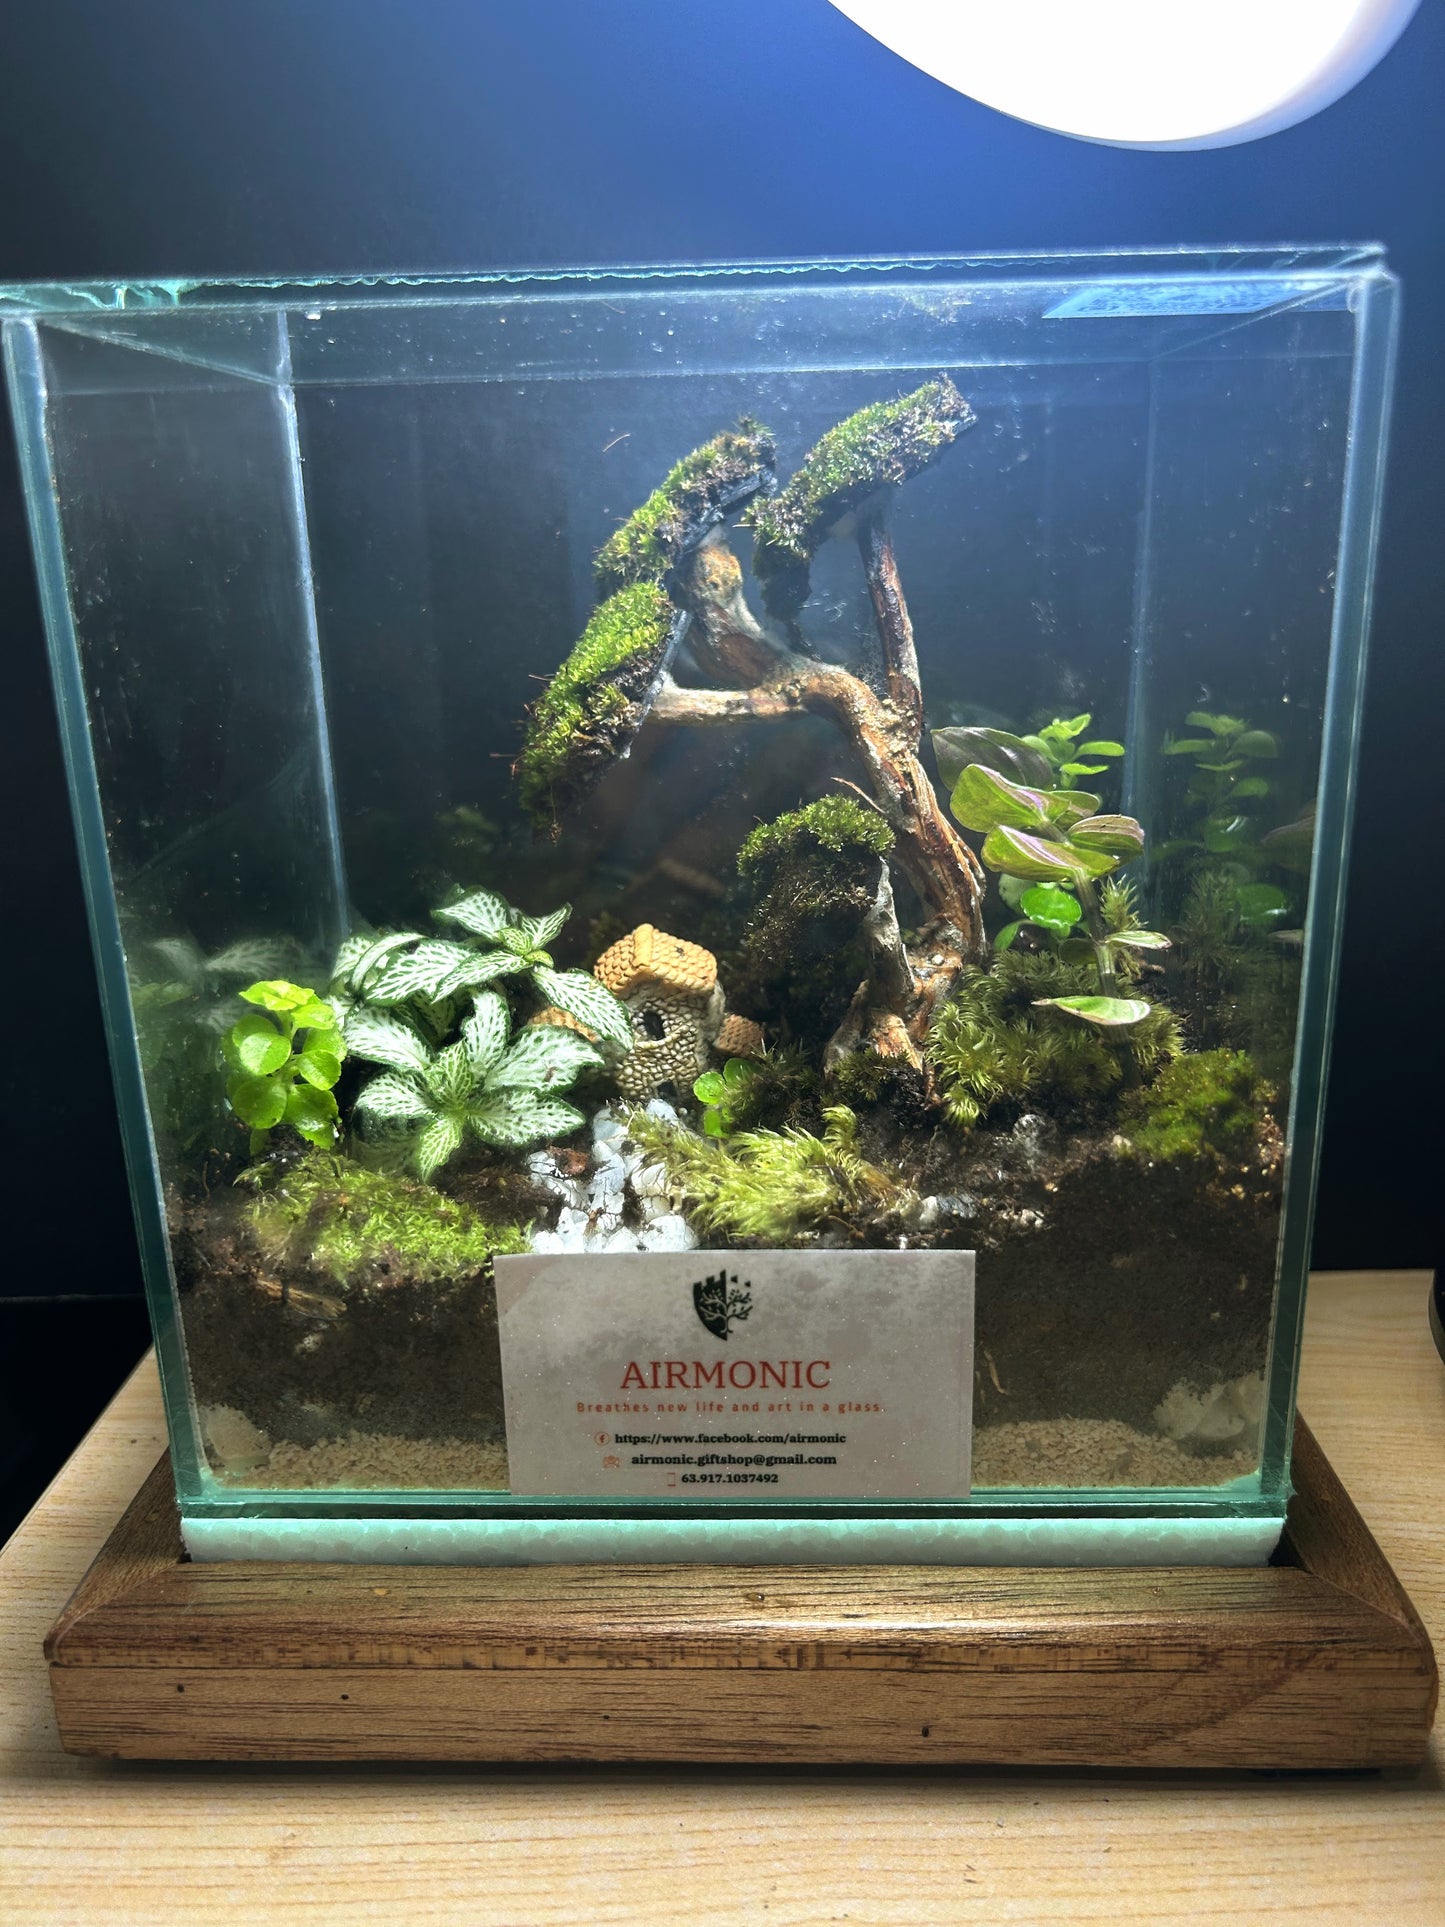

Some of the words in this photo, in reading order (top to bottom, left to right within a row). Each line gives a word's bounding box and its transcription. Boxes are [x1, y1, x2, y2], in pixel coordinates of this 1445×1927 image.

[620, 1360, 831, 1389] AIRMONIC
[576, 1401, 650, 1414] Breathes
[657, 1402, 688, 1413] new
[695, 1400, 724, 1413] life
[731, 1400, 761, 1413] and
[767, 1401, 792, 1413] art
[799, 1400, 815, 1413] in
[821, 1403, 831, 1413] a
[614, 1433, 847, 1446] https://www.facebook.com/airmonic
[631, 1453, 837, 1468] airmonic.giftshop@gmail.com
[680, 1472, 779, 1485] 63.917.1037492
